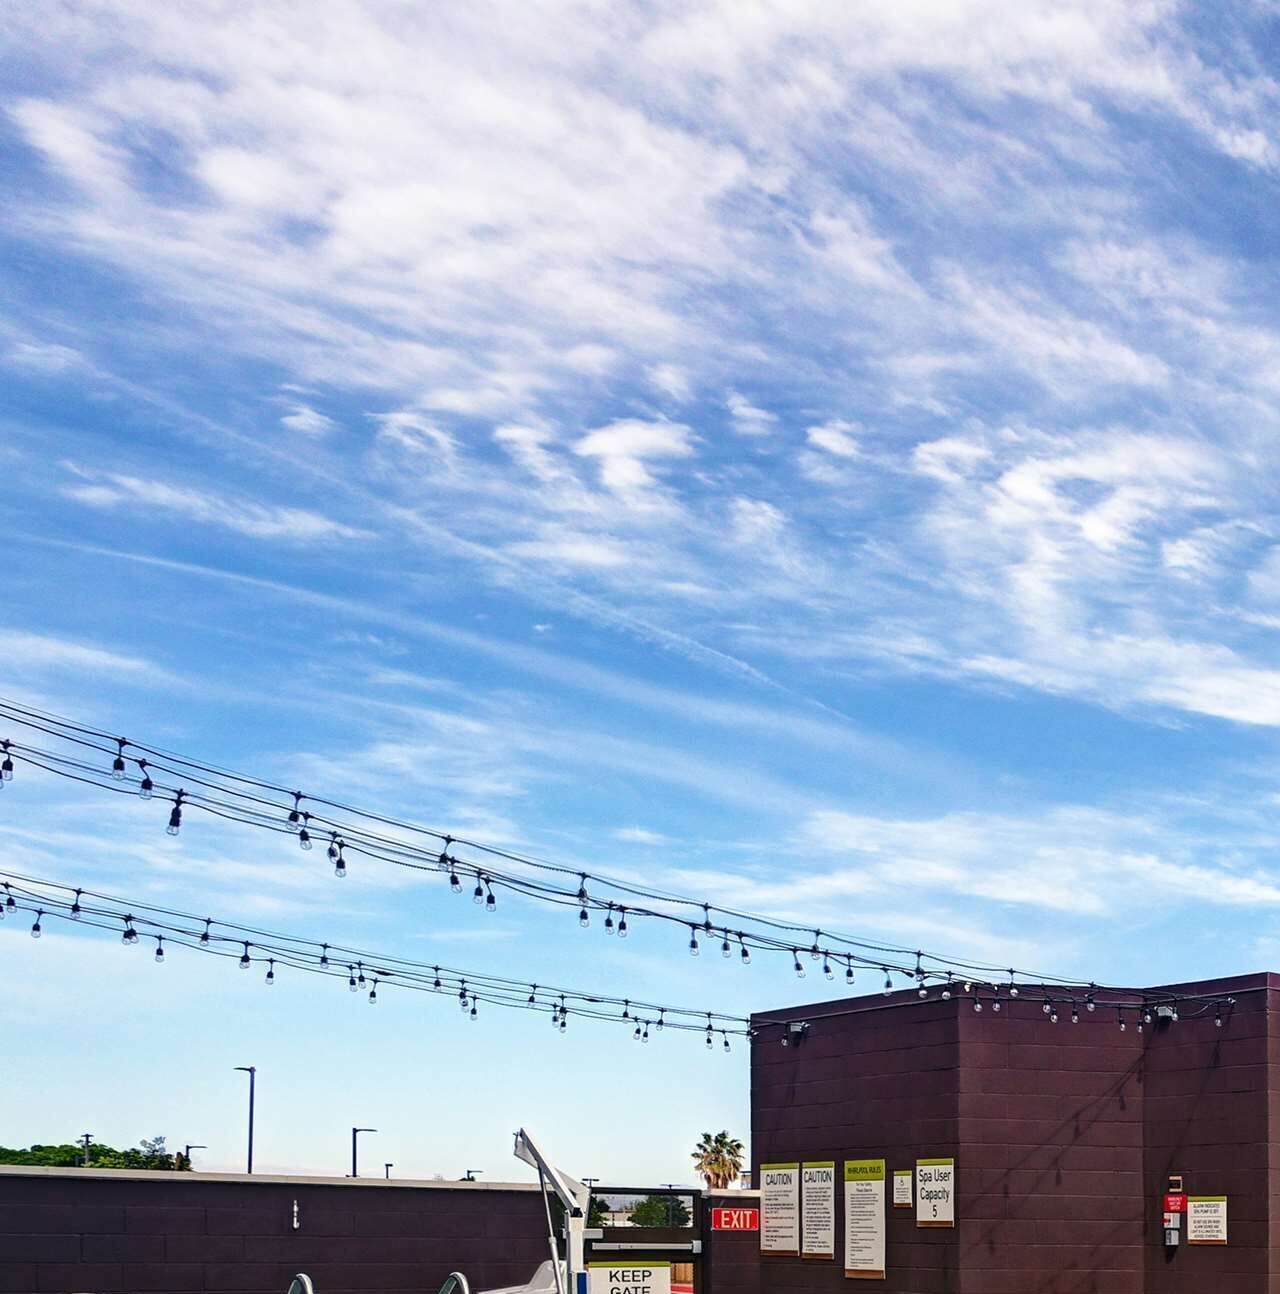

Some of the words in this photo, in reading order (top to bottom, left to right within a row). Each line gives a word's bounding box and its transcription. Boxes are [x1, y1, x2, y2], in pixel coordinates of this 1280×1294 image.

[766, 1173, 792, 1185] CAUTION
[804, 1170, 832, 1183] CAUTION
[919, 1169, 932, 1185] Spa
[934, 1169, 951, 1182] User
[920, 1187, 950, 1203] Capacity
[932, 1205, 938, 1218] 5
[721, 1211, 752, 1229] EXIT
[609, 1270, 652, 1283] KEEP
